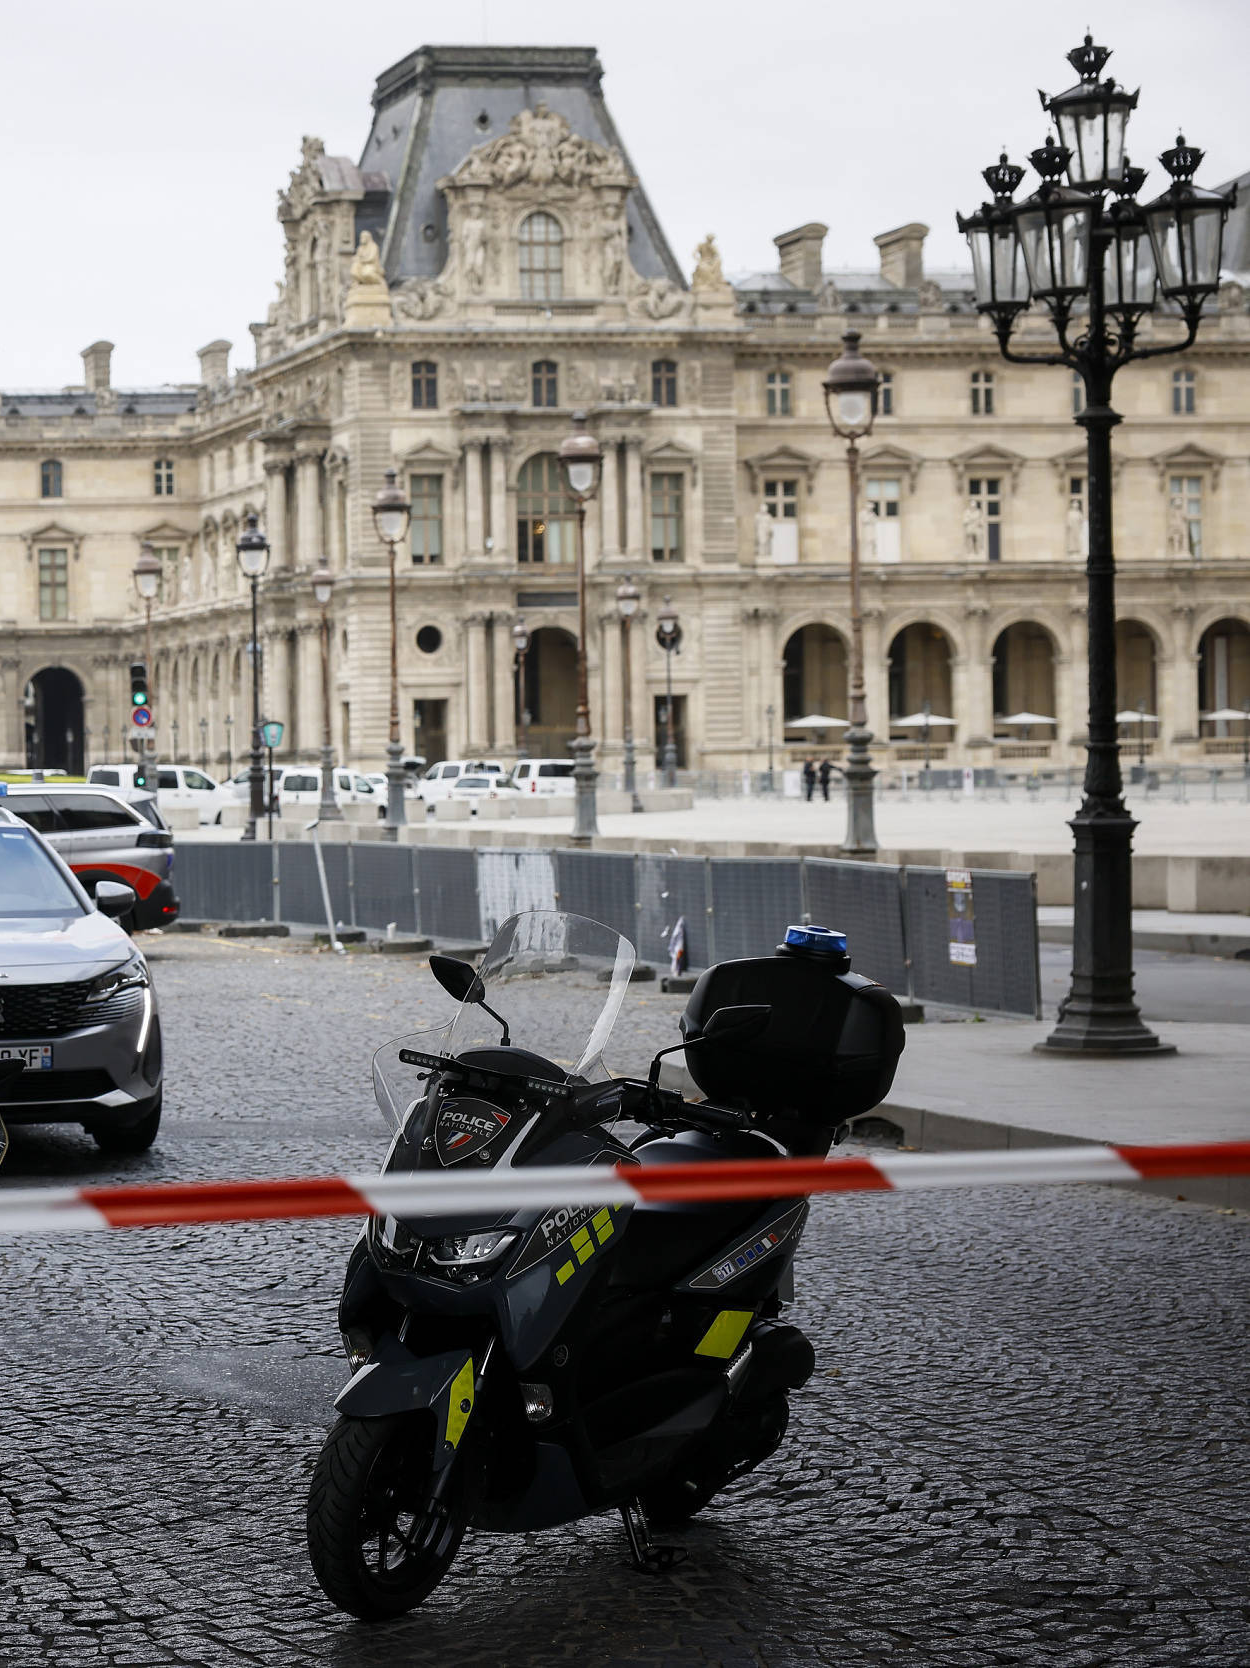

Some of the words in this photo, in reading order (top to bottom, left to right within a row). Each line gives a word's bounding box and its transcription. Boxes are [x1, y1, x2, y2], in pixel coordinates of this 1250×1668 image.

[439, 1121, 492, 1138] NATIONALE
[441, 1111, 496, 1132] POLICE
[540, 1203, 584, 1238] POL
[546, 1206, 594, 1247] NATIONA
